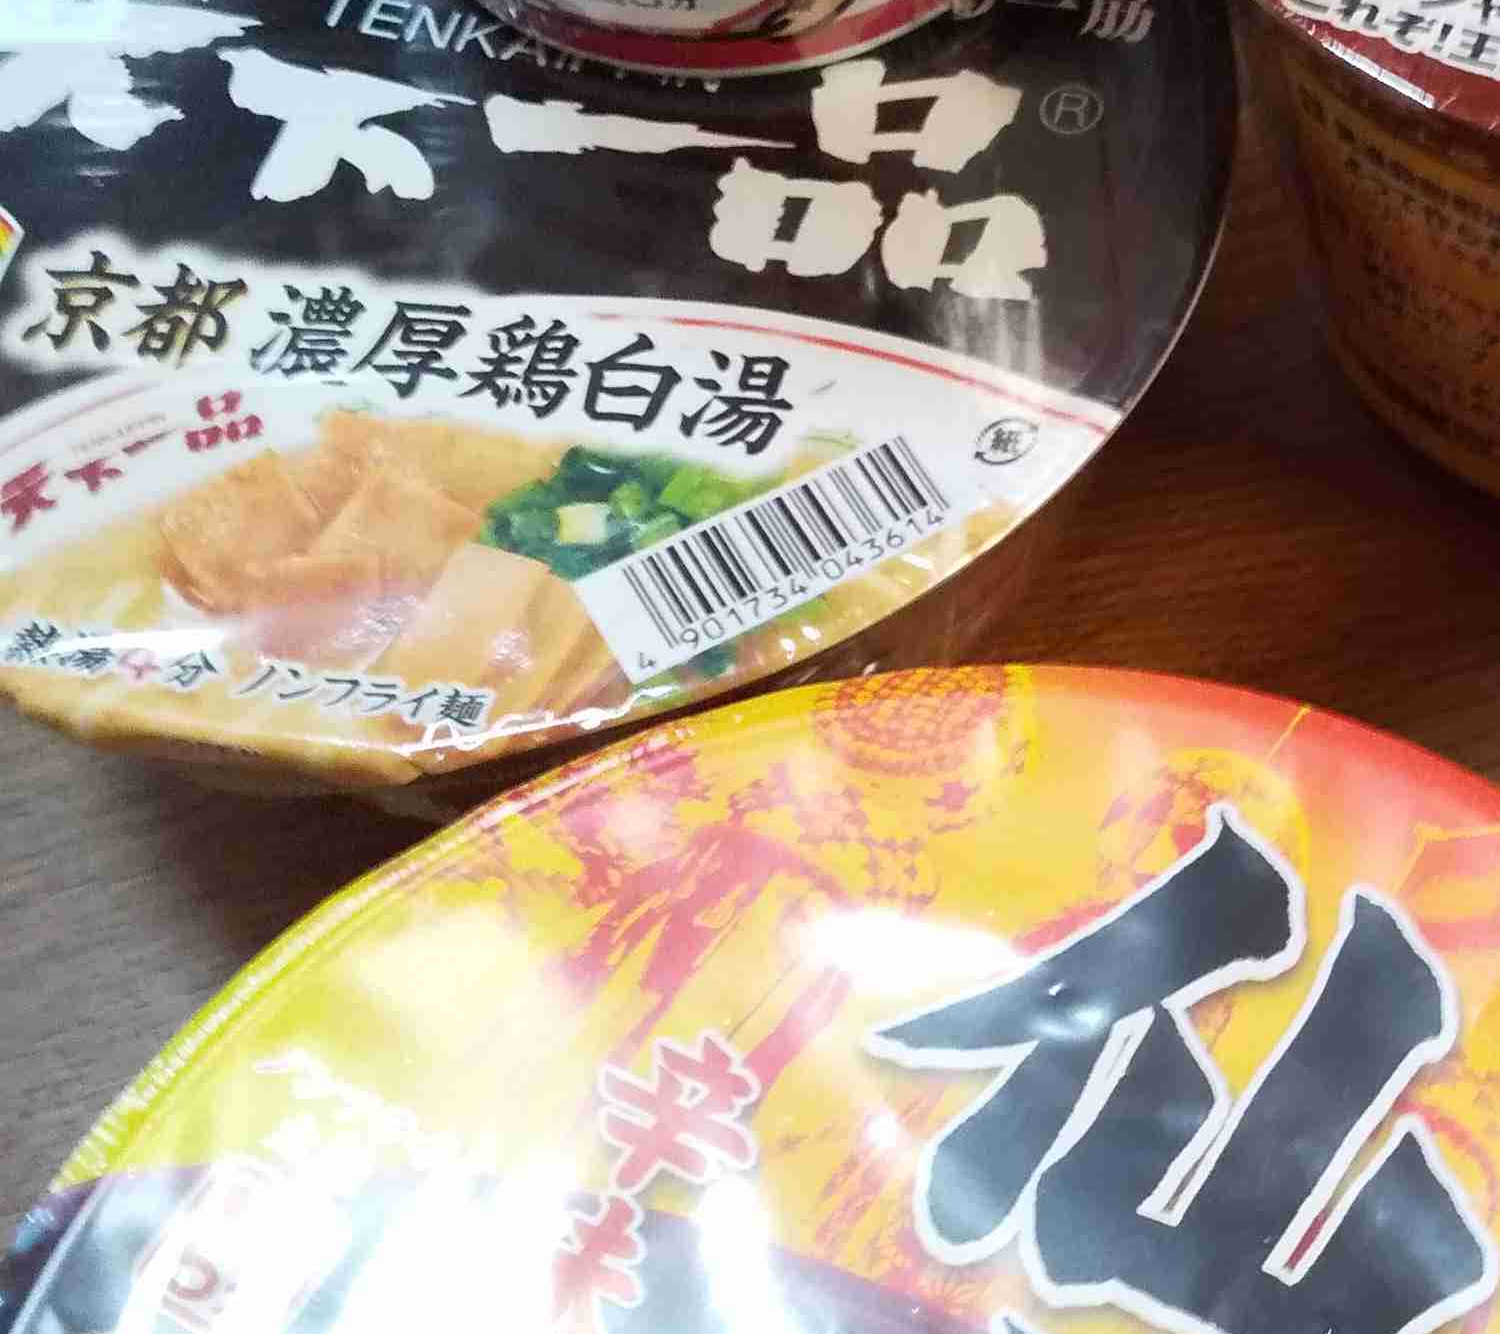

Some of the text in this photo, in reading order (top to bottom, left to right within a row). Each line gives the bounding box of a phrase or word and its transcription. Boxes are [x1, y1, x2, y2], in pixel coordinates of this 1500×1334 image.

[20, 247, 798, 459] 京都 濃厚鶏白湯
[635, 506, 946, 671] 4 901734 043614
[237, 661, 490, 729] ノンフライ麺
